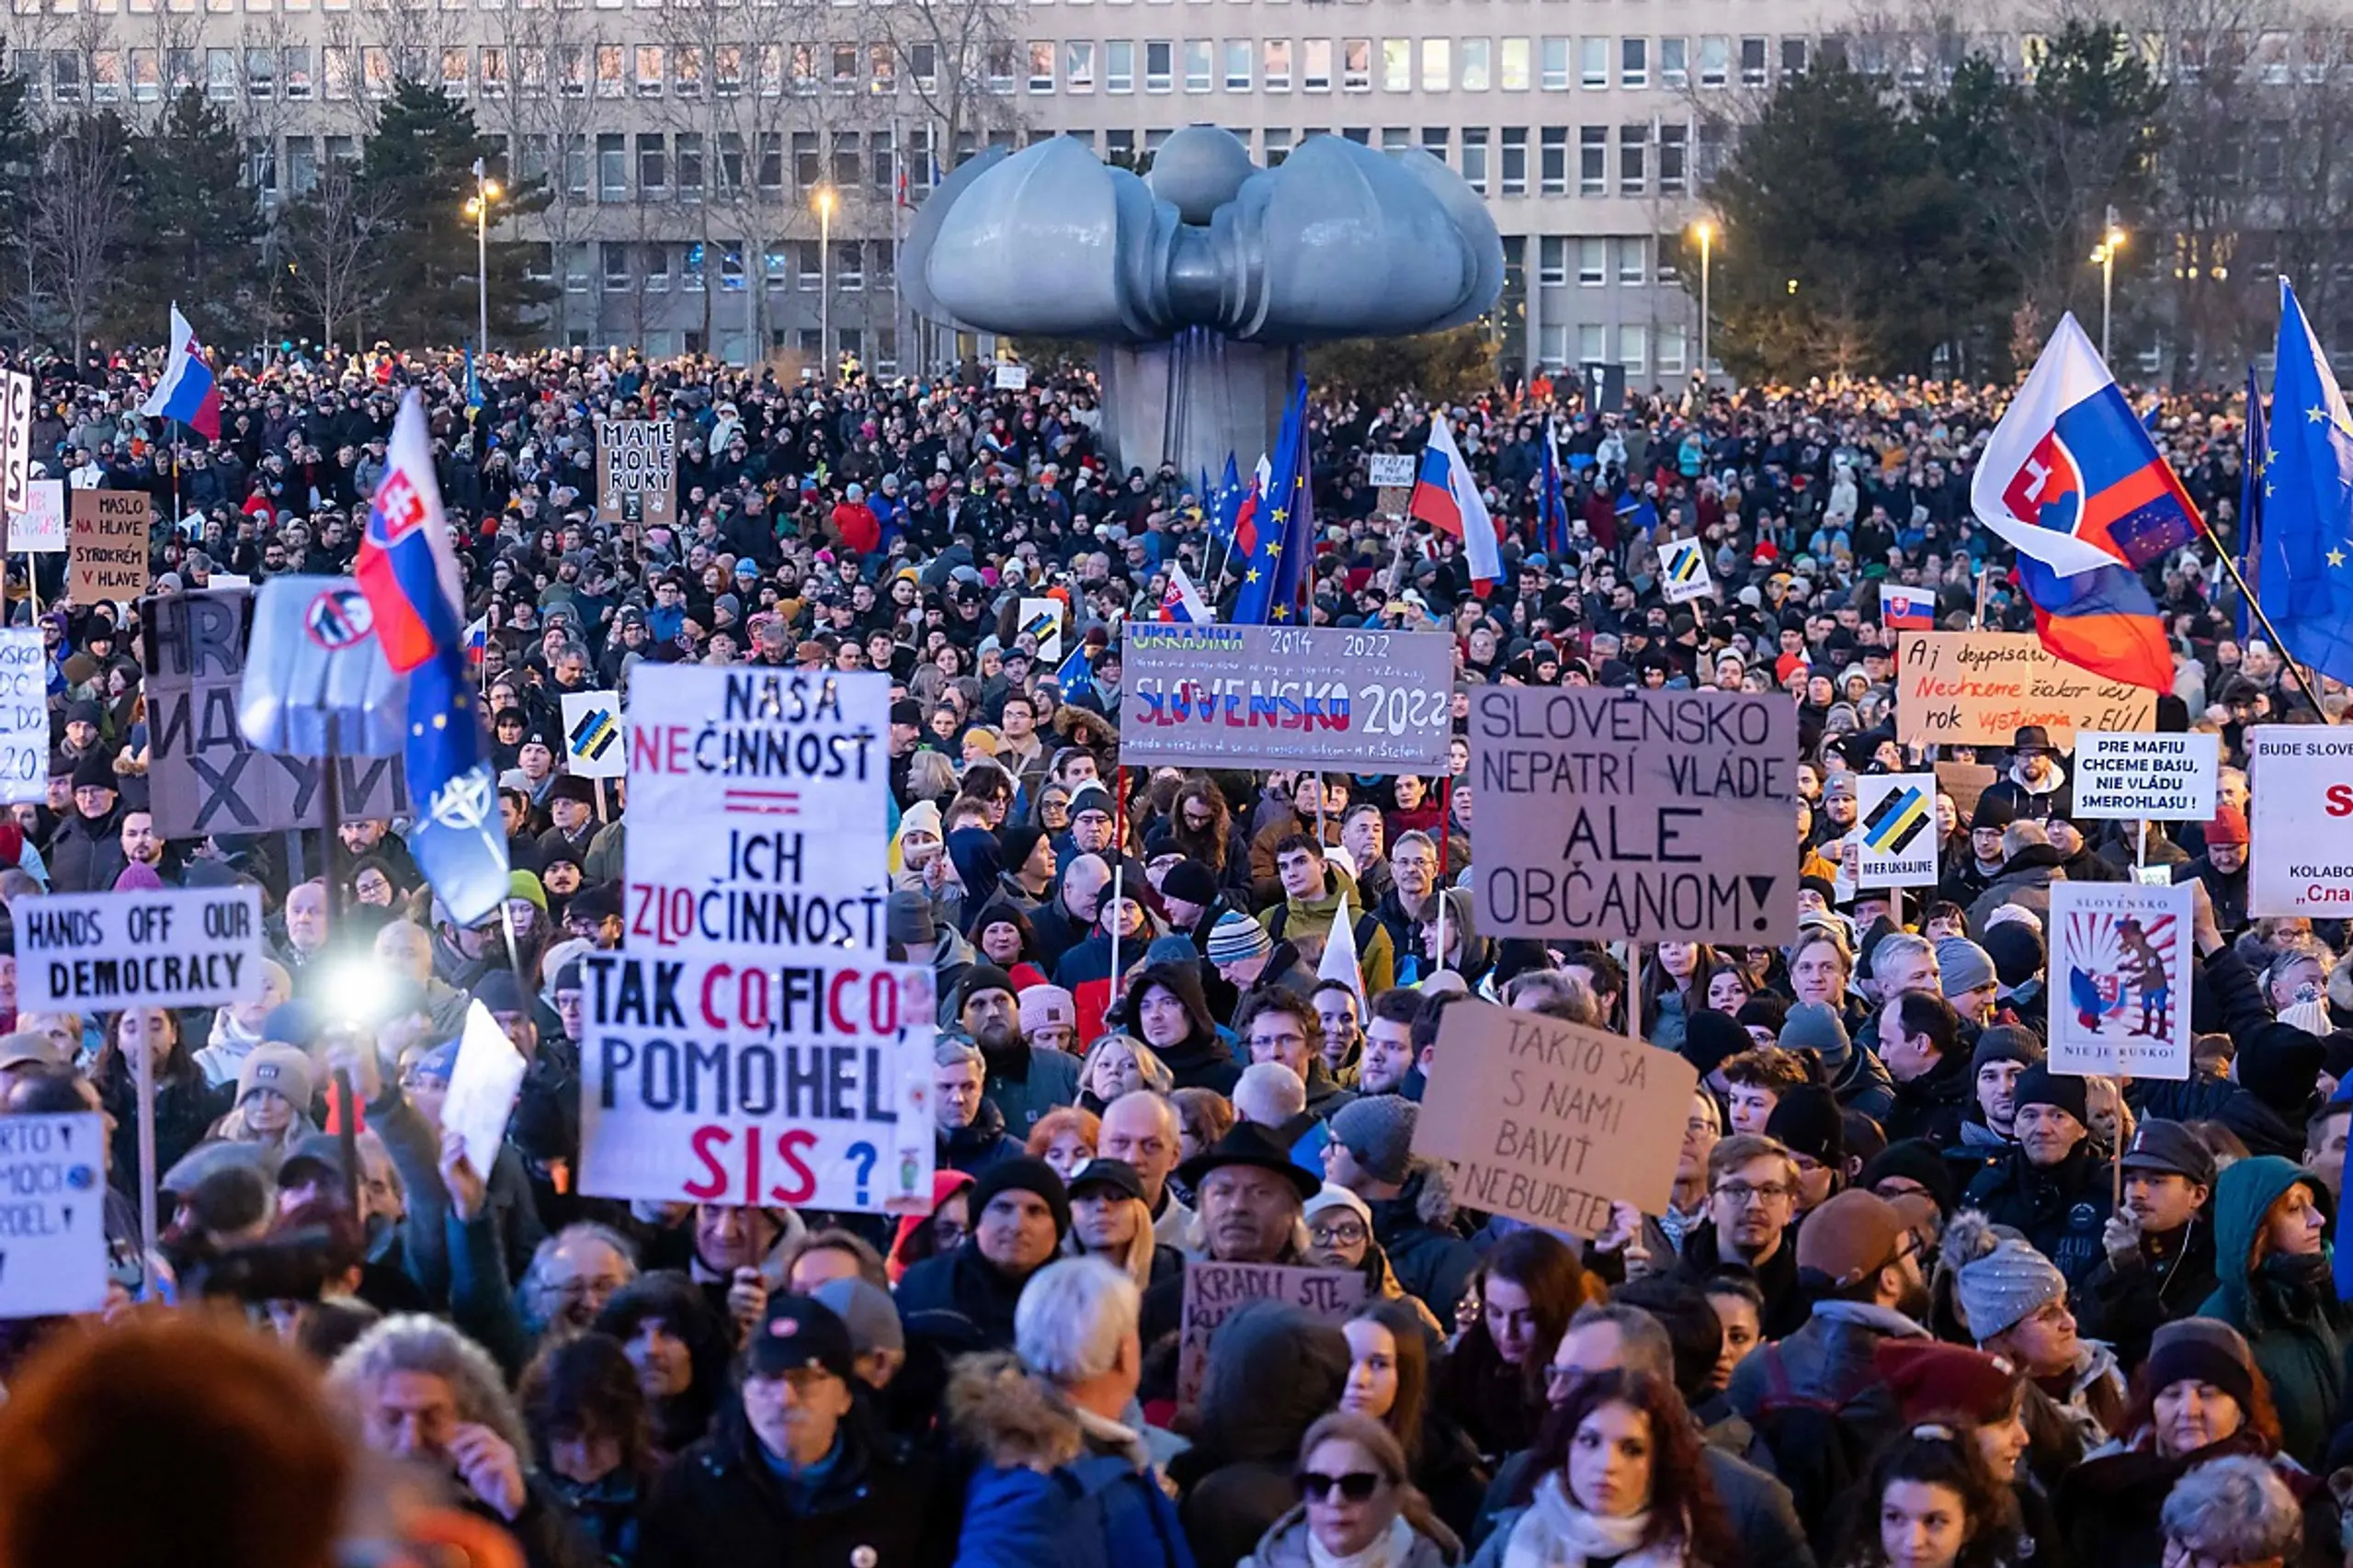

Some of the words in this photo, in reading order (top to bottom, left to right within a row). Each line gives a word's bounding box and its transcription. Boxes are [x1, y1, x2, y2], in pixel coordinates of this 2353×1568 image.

[602, 423, 673, 447] MAME
[610, 449, 671, 470] HOLE
[610, 471, 672, 491] RUKY
[100, 498, 143, 515] MASLO
[76, 518, 92, 533] NA
[100, 521, 142, 536] HLAVE
[82, 570, 93, 585] V
[98, 571, 140, 587] HLAVE
[1131, 625, 1244, 650] UKRAJINA
[1343, 634, 1390, 657] 2022
[1907, 640, 1940, 672] Aj
[1915, 676, 2021, 699] Nechceme
[1137, 678, 1349, 732] SLOVENSKO
[1480, 692, 1769, 746] SLOVENSKO
[1926, 705, 1962, 729] rok
[2098, 741, 2129, 753] PRE
[2133, 741, 2186, 754] MAFIU
[2259, 743, 2302, 756] BUDE
[1483, 747, 1637, 795] NEPATRÍ
[1667, 750, 1792, 802] VLÁDE,
[2082, 758, 2148, 772] CHCEME
[2153, 758, 2199, 774] BASU,
[2096, 777, 2122, 790] NIE
[2128, 775, 2183, 790] VLÁDU
[2082, 795, 2187, 809] SMEROHLASU
[1563, 805, 1703, 862] ALE
[730, 830, 802, 883] ICH
[631, 877, 882, 948] ZLOČINNOSŤ
[1488, 861, 1776, 932] OBČANOM!
[2076, 898, 2168, 909] SLOVENSKO
[27, 909, 103, 949] HANDS
[128, 903, 174, 943] OFF
[203, 902, 250, 938] OUR
[50, 953, 244, 999] DEMOCRACY
[587, 956, 687, 1028] TAK
[1507, 1018, 1604, 1075] TAKTO
[1617, 1050, 1646, 1089] SA
[2064, 1046, 2089, 1056] NIE
[2097, 1047, 2109, 1058] JE
[2120, 1047, 2174, 1058] RUSKO!
[600, 1037, 898, 1123] POMOHEL
[1503, 1070, 1525, 1108] S
[1540, 1081, 1623, 1135] NAMI
[682, 1124, 821, 1205] SIS
[844, 1141, 878, 1206] ?
[1298, 1276, 1349, 1314] STE,
